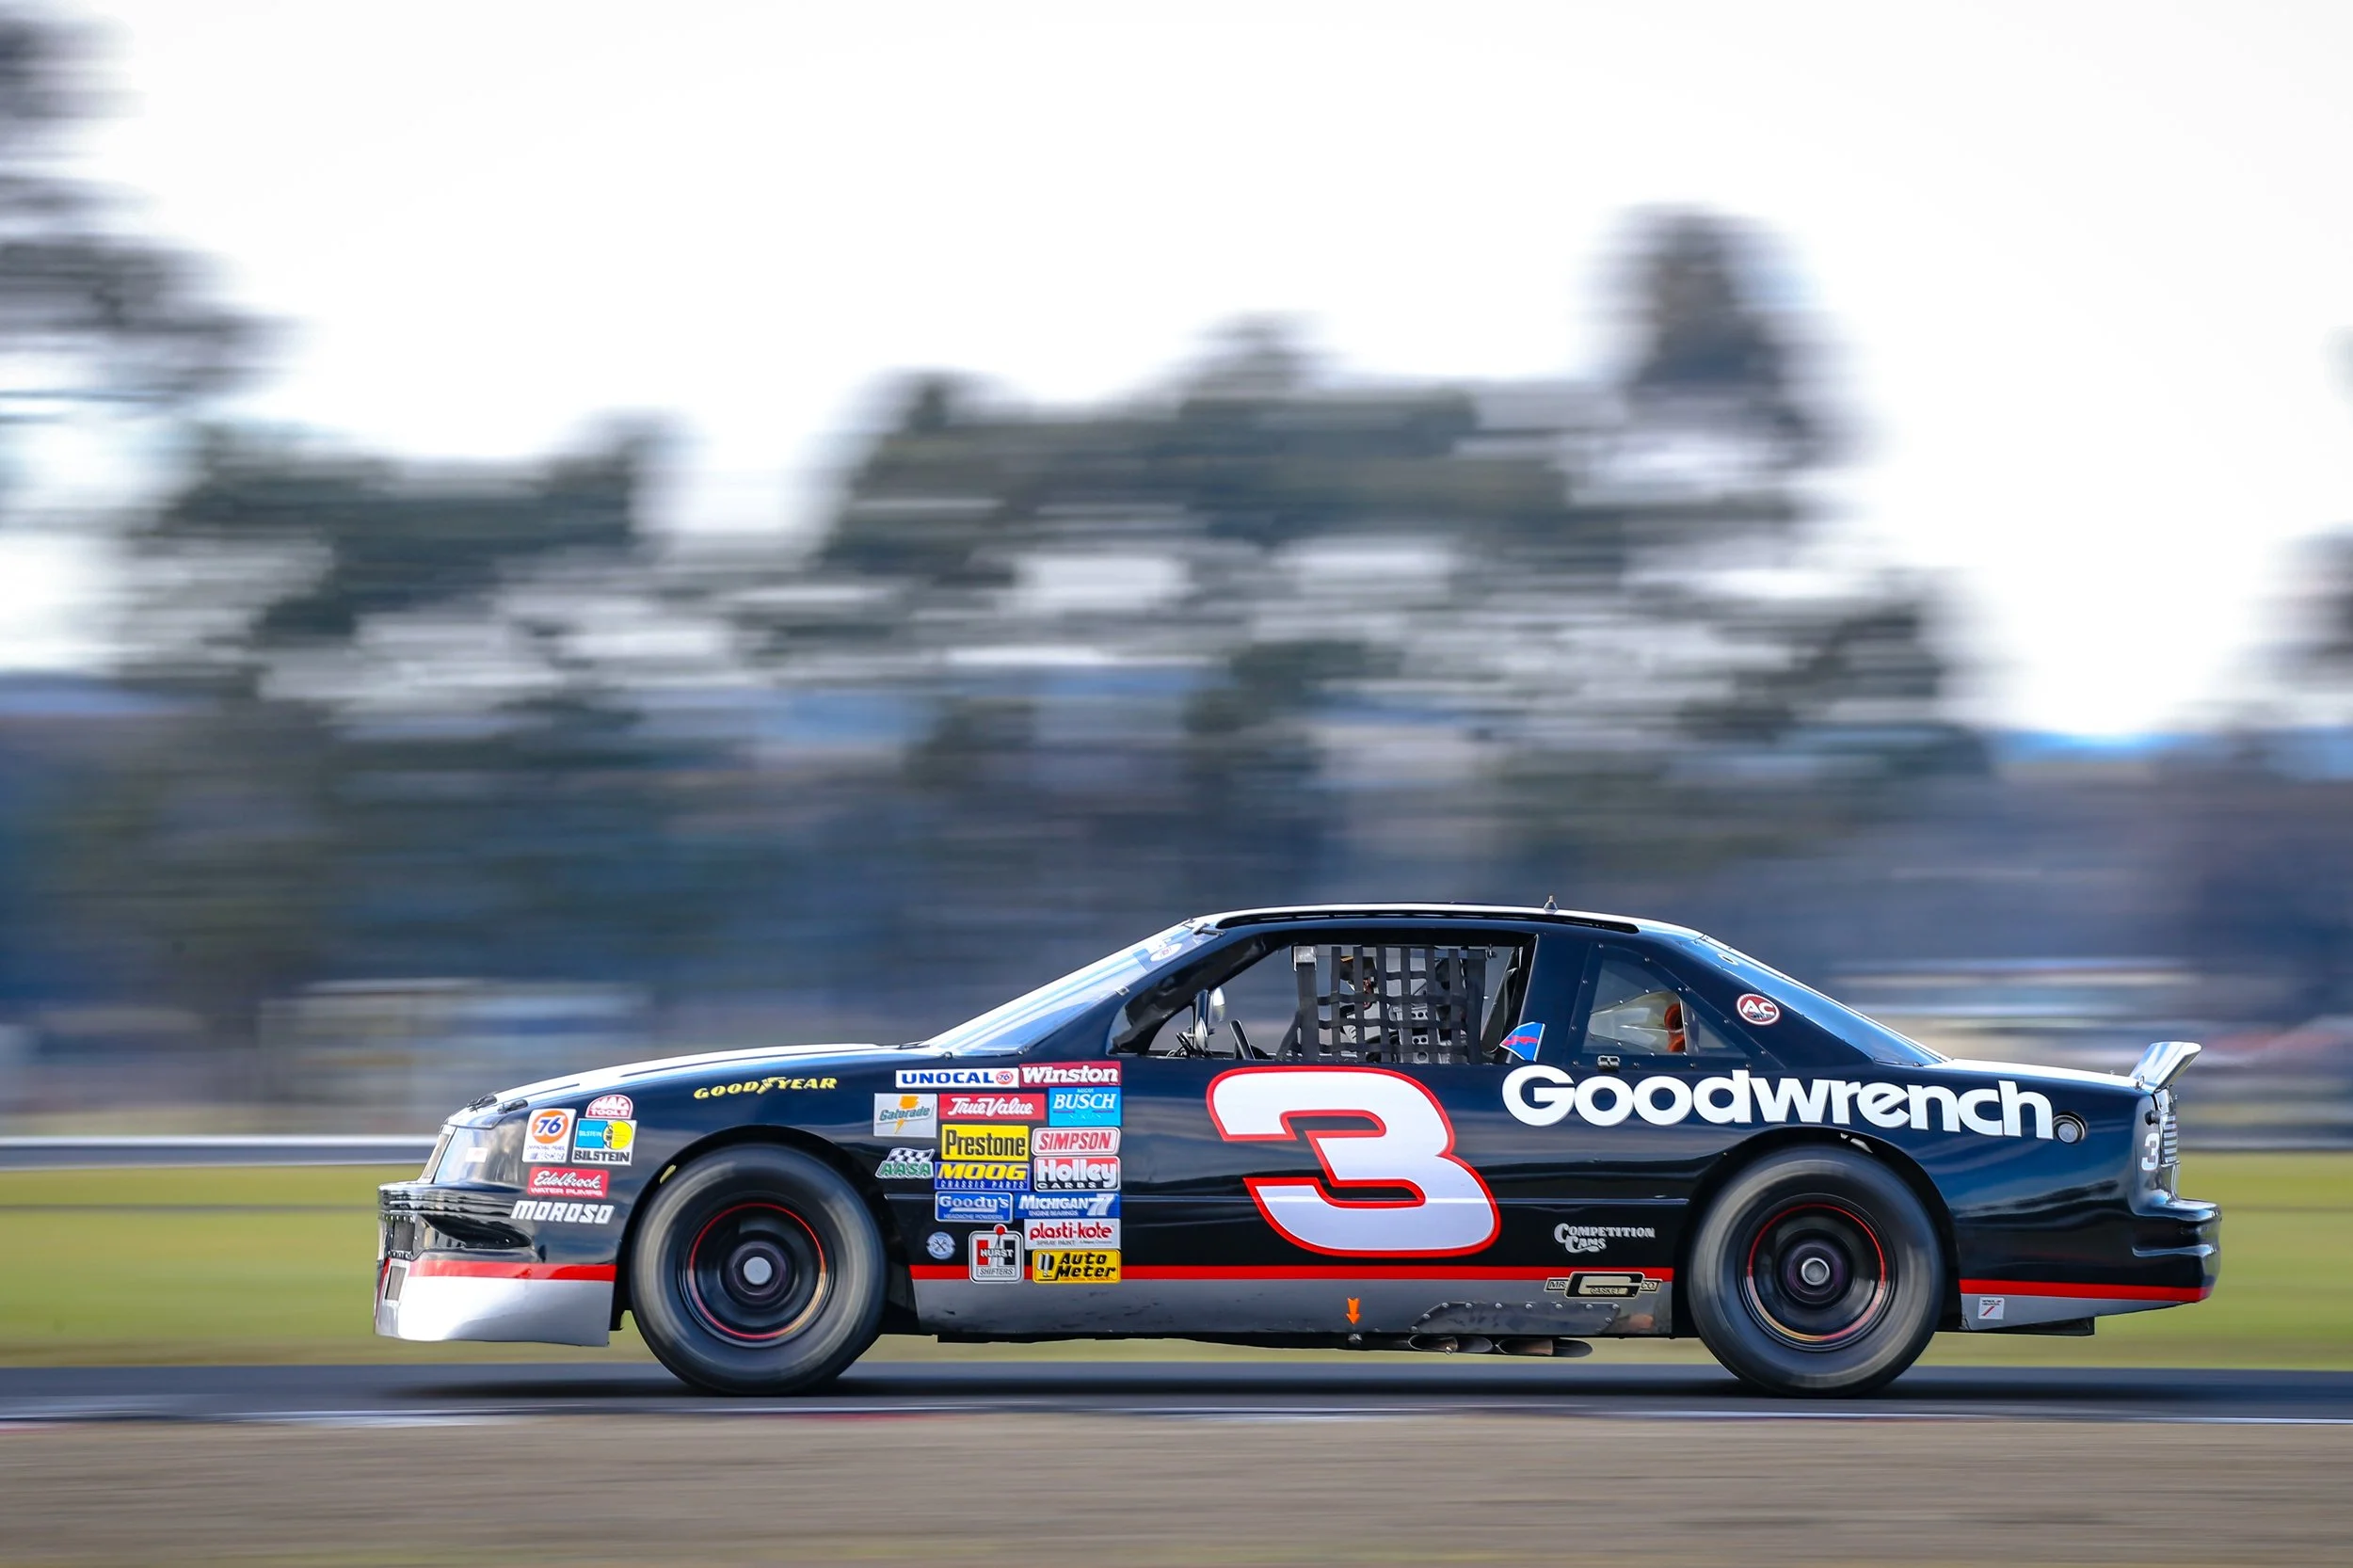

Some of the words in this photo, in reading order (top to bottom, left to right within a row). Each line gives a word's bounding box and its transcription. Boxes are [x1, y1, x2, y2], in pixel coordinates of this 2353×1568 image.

[1742, 1000, 1775, 1016] AC
[901, 1071, 994, 1084] UNOCAL
[998, 1072, 1012, 1081] 76
[1021, 1064, 1119, 1083] Winston
[693, 1076, 838, 1100] GOODYEAR
[594, 1096, 630, 1112] MAC
[1052, 1093, 1116, 1110] BUSCH
[1502, 1064, 2054, 1140] Goodwrench
[879, 1105, 931, 1122] Gatorade
[535, 1115, 565, 1136] 76
[944, 1128, 1026, 1157] Prestone
[1039, 1131, 1112, 1150] SIMPSON
[573, 1149, 631, 1162] BILSTEIN
[2140, 1132, 2160, 1172] 3
[880, 1161, 933, 1177] AASA
[1207, 1066, 1500, 1257] 3
[533, 1170, 603, 1189] Edelbrock
[937, 1163, 1027, 1180] MOOG
[1036, 1159, 1117, 1189] Holley
[941, 1180, 985, 1189] CHASSIS
[991, 1180, 1025, 1190] PARTS
[938, 1195, 1009, 1213] Goody's
[1018, 1194, 1089, 1209] MICHIGAN
[509, 1200, 616, 1224] MOROSO
[1030, 1221, 1112, 1240] plasti-kote
[1554, 1223, 1656, 1243] COMPETITION
[980, 1249, 1014, 1257] HURST
[1564, 1235, 1607, 1254] CAMS
[1059, 1252, 1107, 1264] Auto
[1056, 1265, 1116, 1278] Meter
